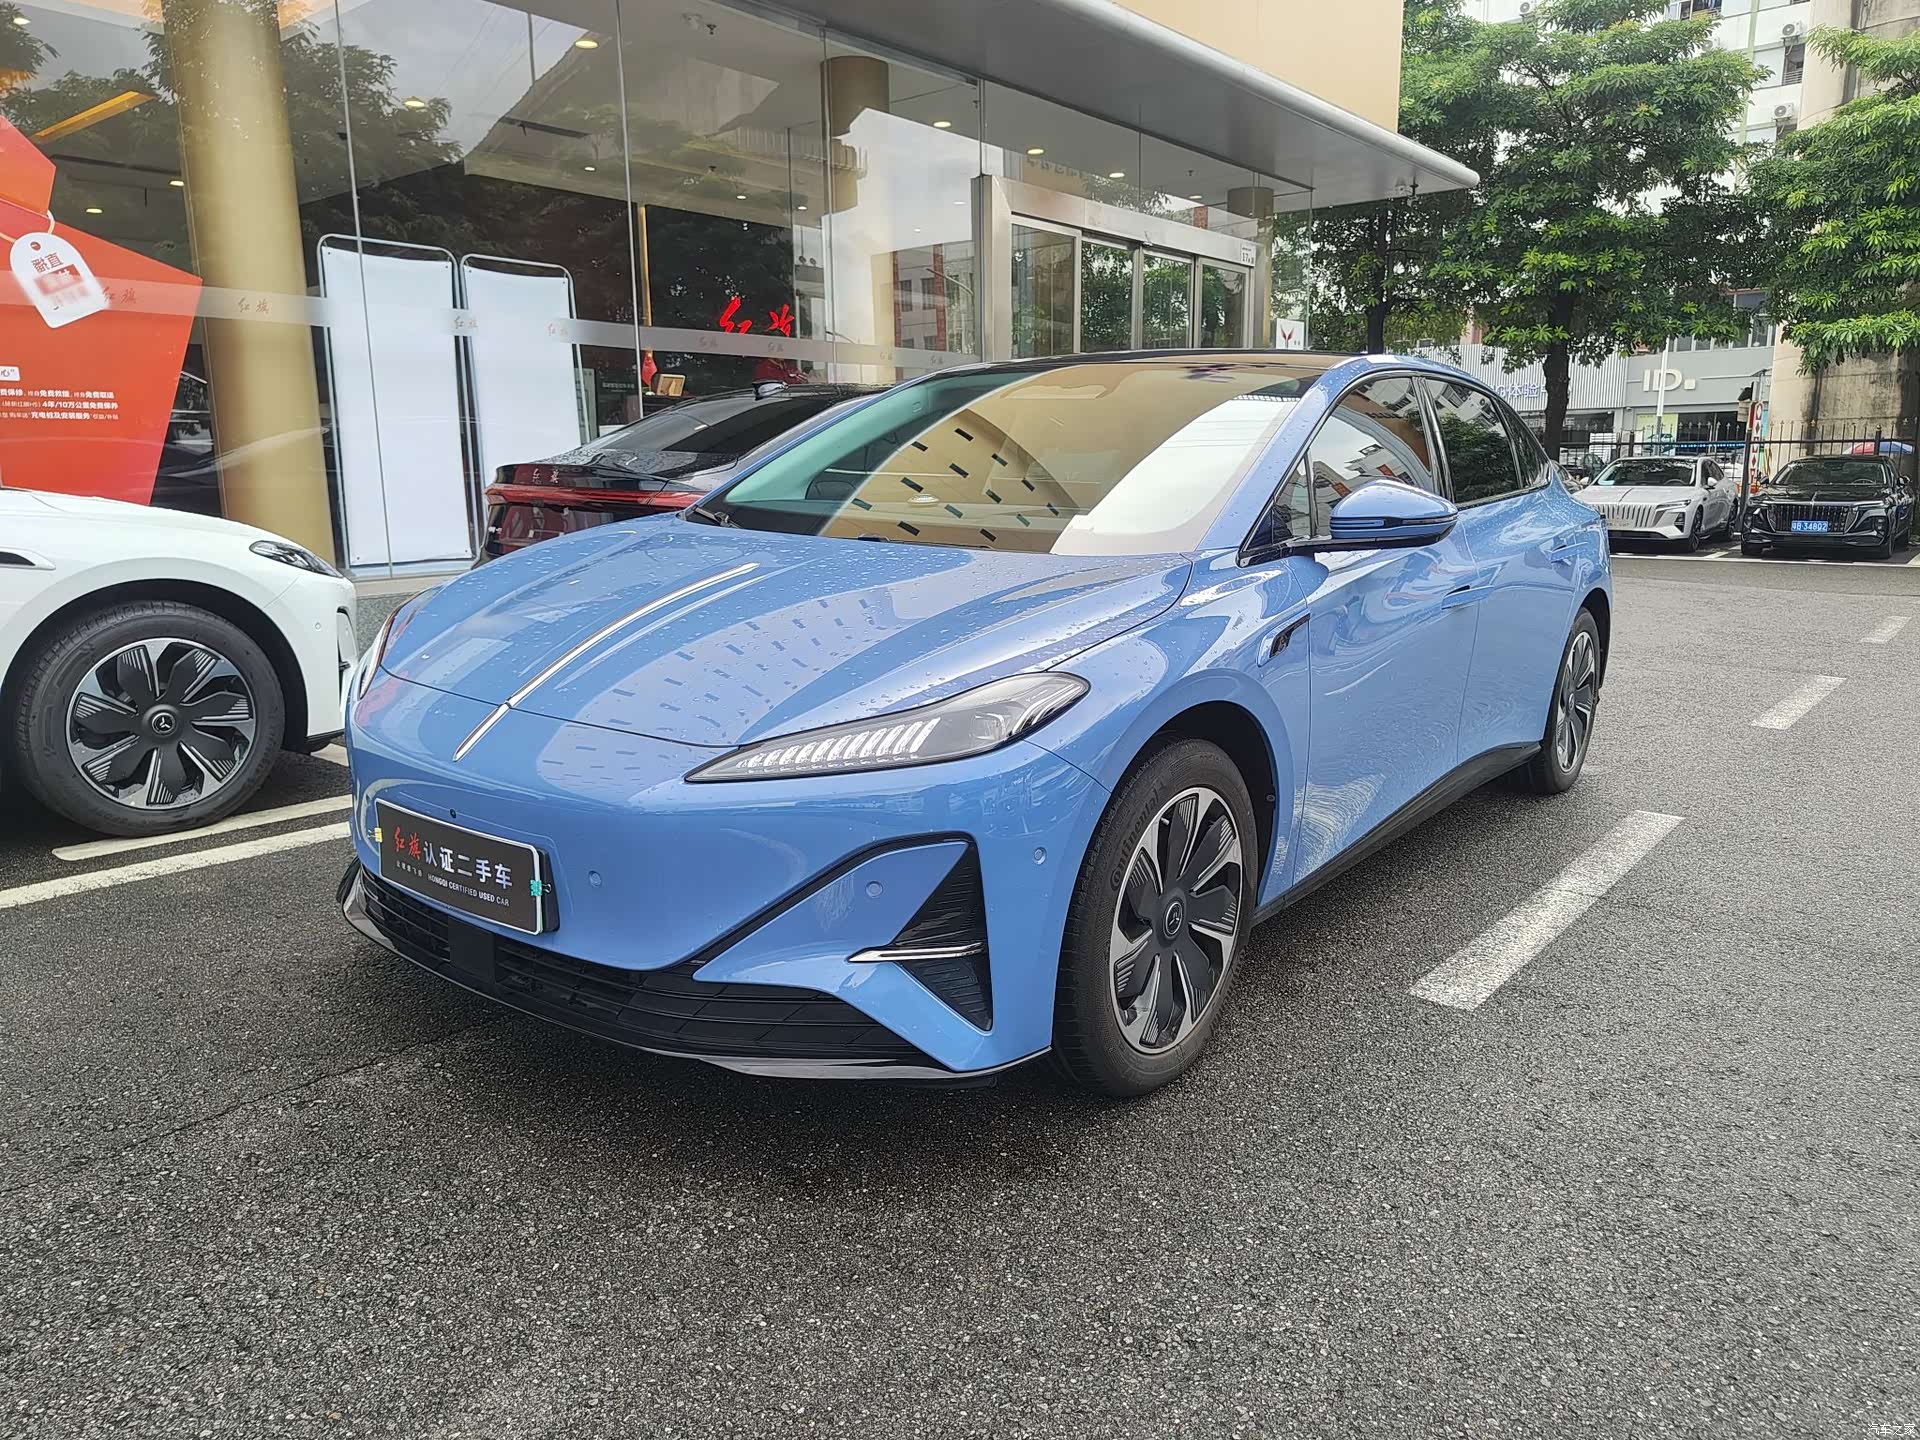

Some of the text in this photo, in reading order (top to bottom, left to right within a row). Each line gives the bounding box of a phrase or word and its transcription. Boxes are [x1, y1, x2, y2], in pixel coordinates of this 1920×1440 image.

[449, 881, 478, 897] CERTIFIED
[478, 890, 495, 903] USED
[496, 897, 510, 907] CAR
